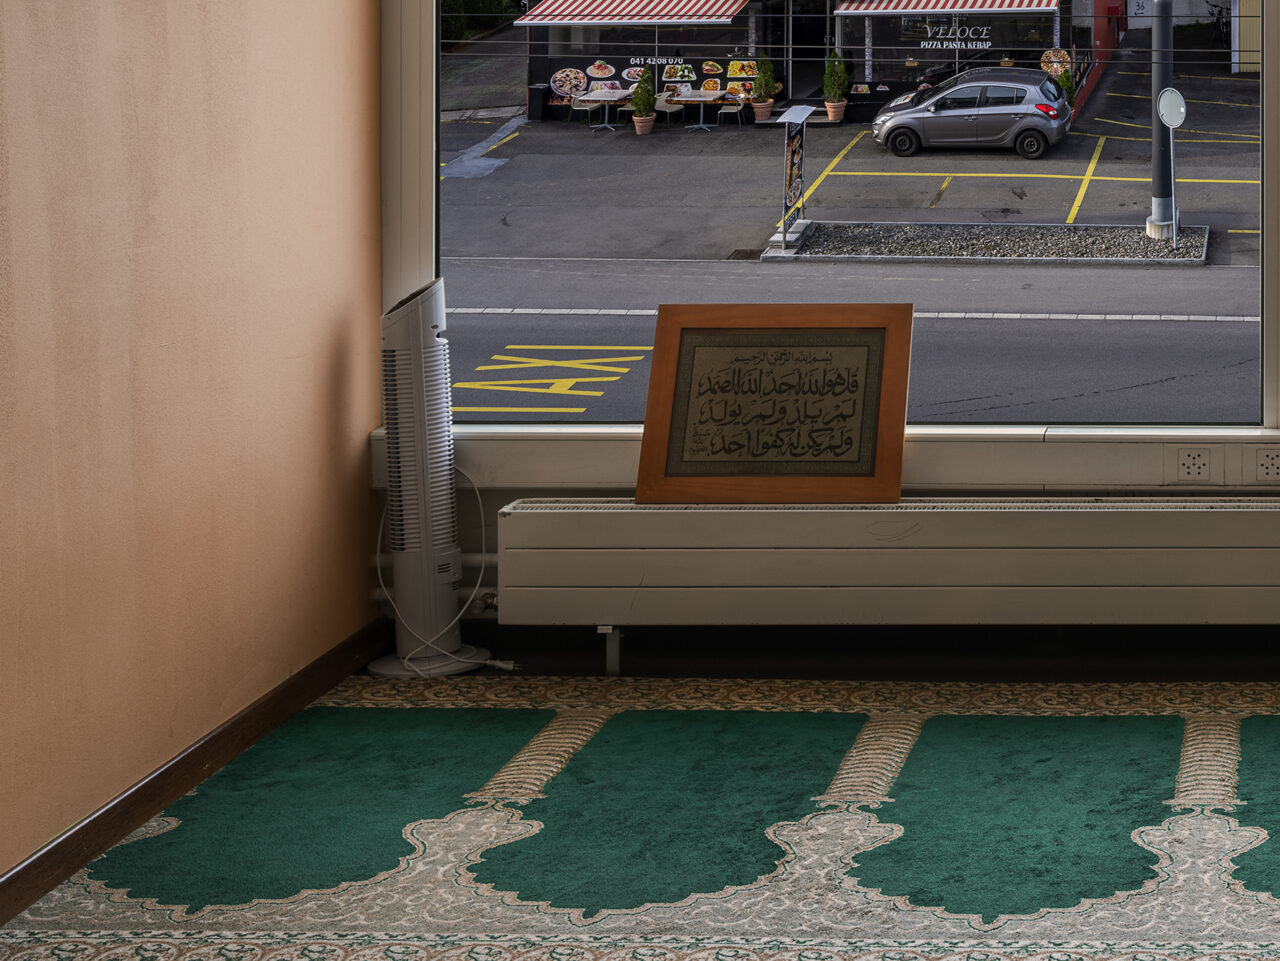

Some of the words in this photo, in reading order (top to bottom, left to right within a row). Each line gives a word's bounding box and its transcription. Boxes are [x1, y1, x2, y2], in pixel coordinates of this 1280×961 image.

[1135, 1, 1145, 11] 36
[922, 24, 991, 39] VELOCE
[920, 41, 942, 49] PIZZA
[943, 41, 966, 49] PASTA
